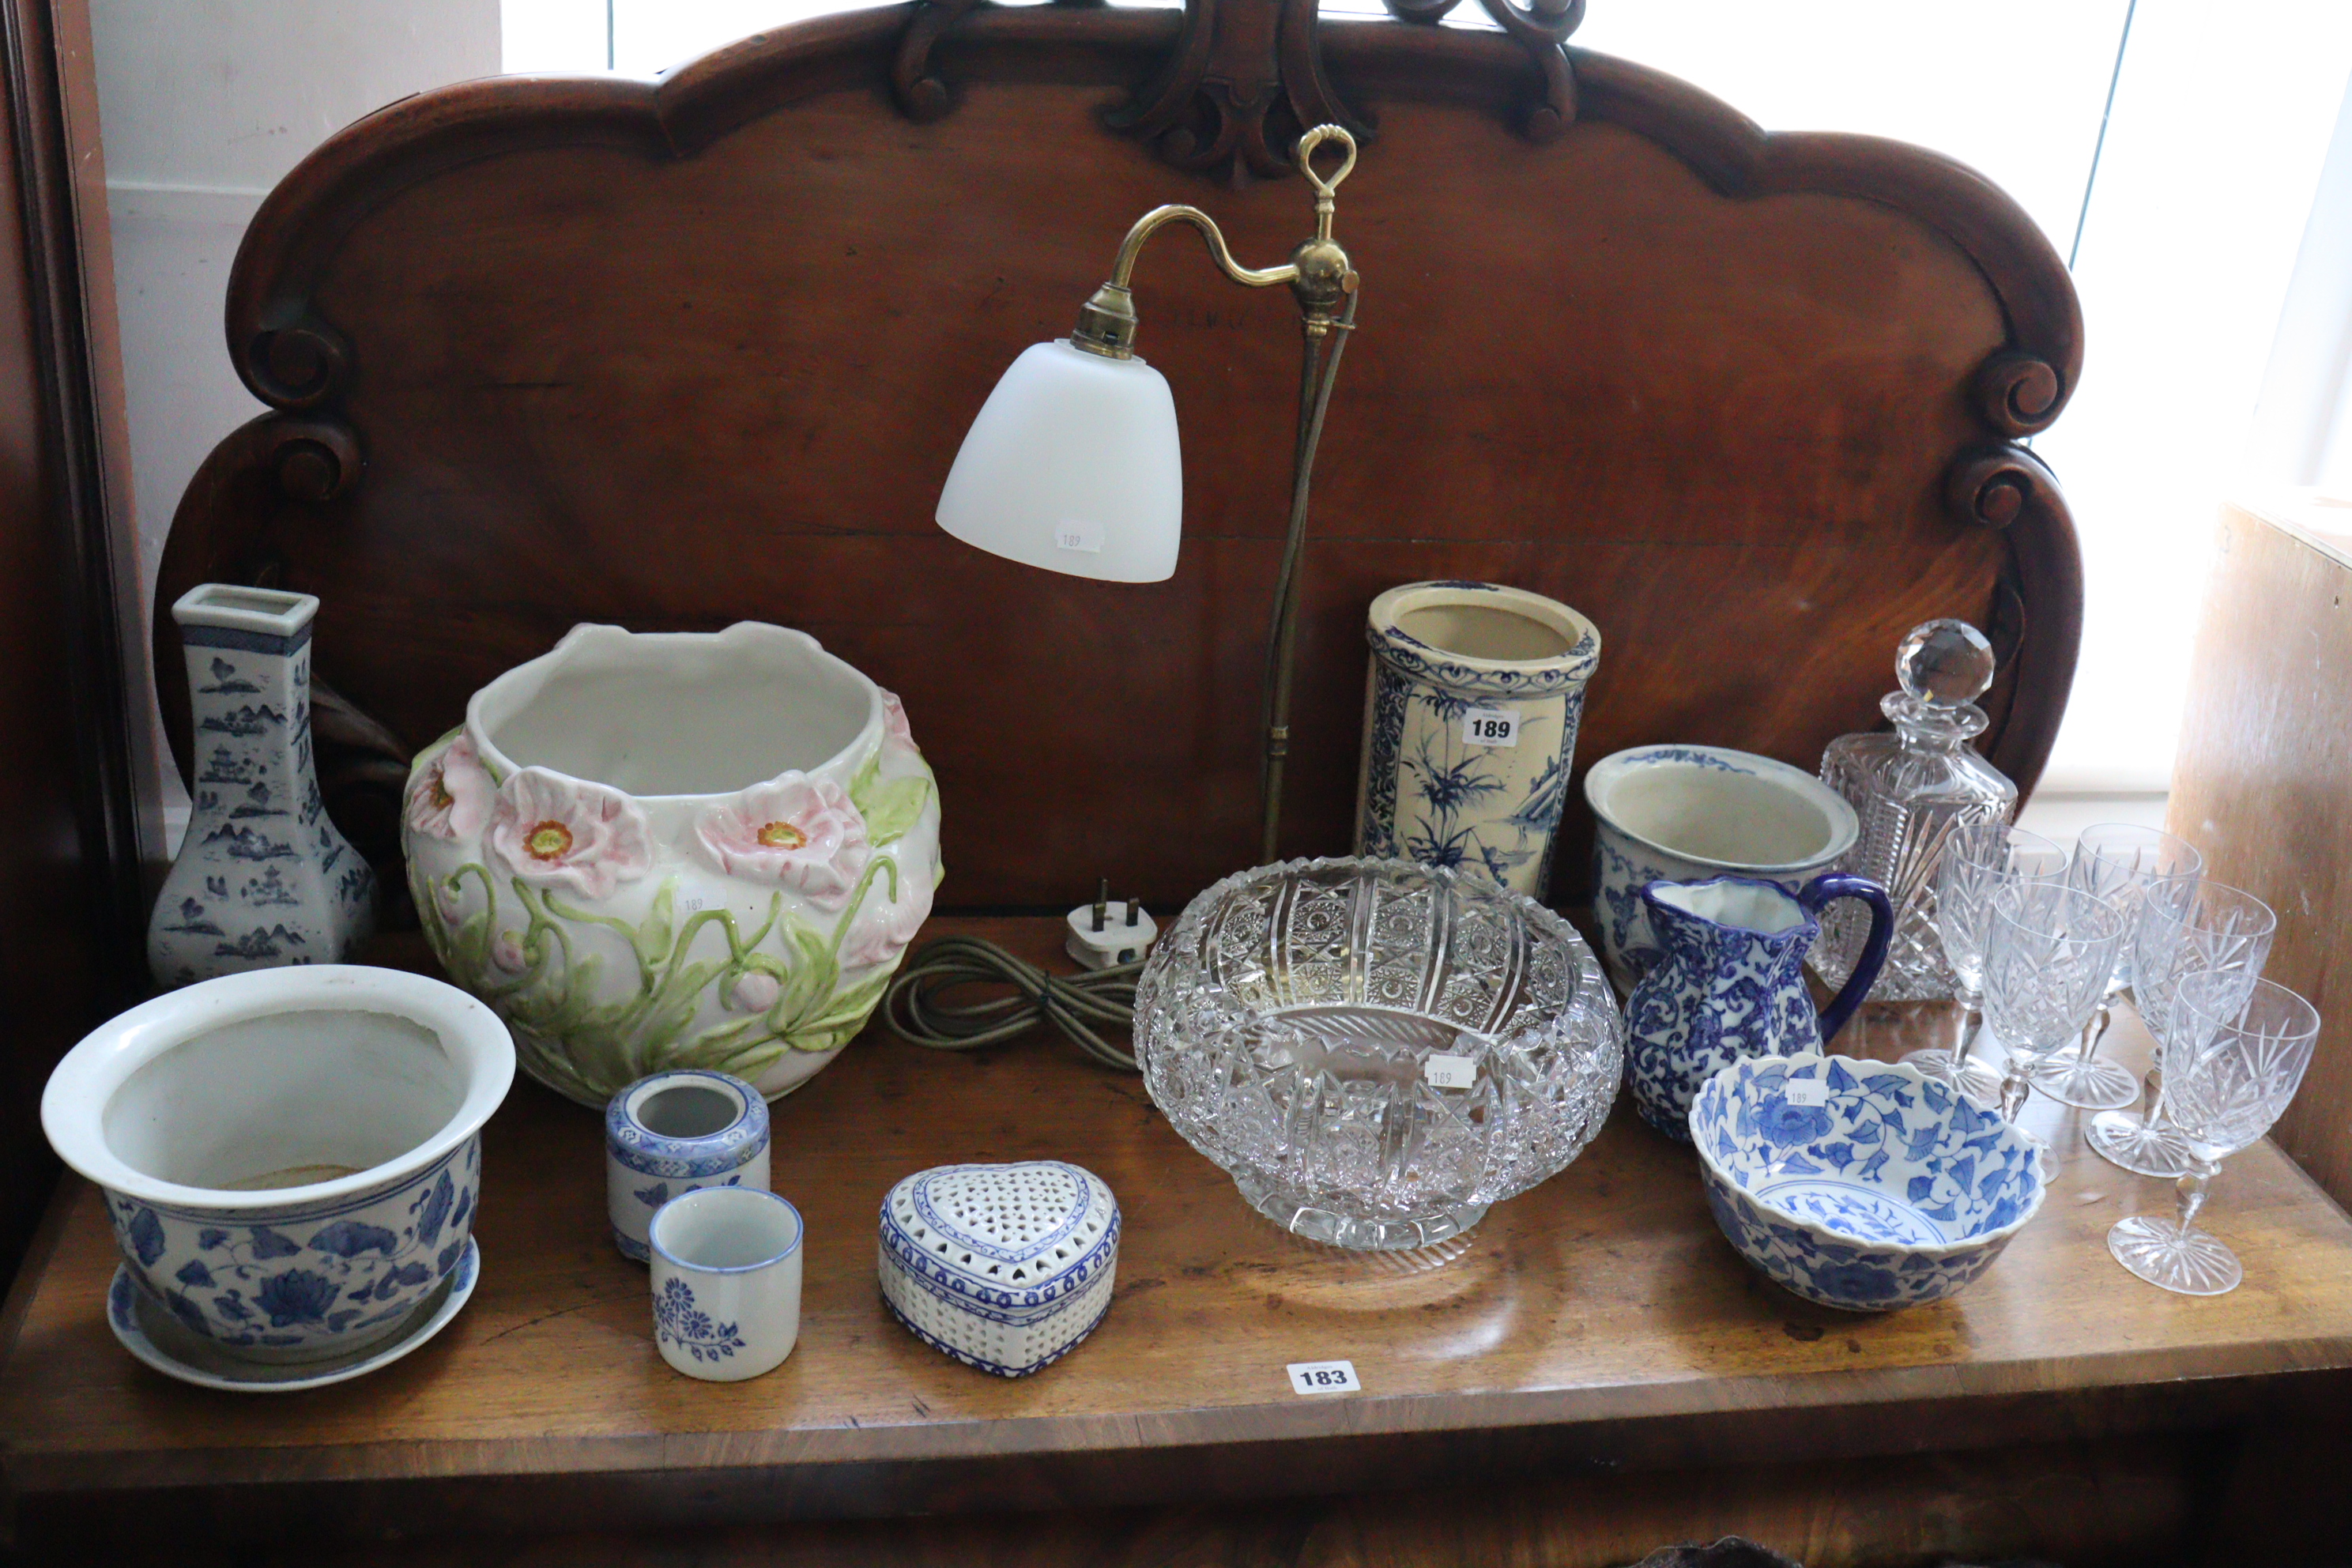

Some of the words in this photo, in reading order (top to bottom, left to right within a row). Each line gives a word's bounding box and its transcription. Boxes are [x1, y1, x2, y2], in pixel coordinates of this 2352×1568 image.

[1064, 534, 1080, 546] 189
[1472, 719, 1510, 738] 189
[686, 899, 703, 910] 189
[1434, 1072, 1452, 1084] 189
[1792, 1092, 1807, 1103] 189
[1300, 1370, 1348, 1386] 183
